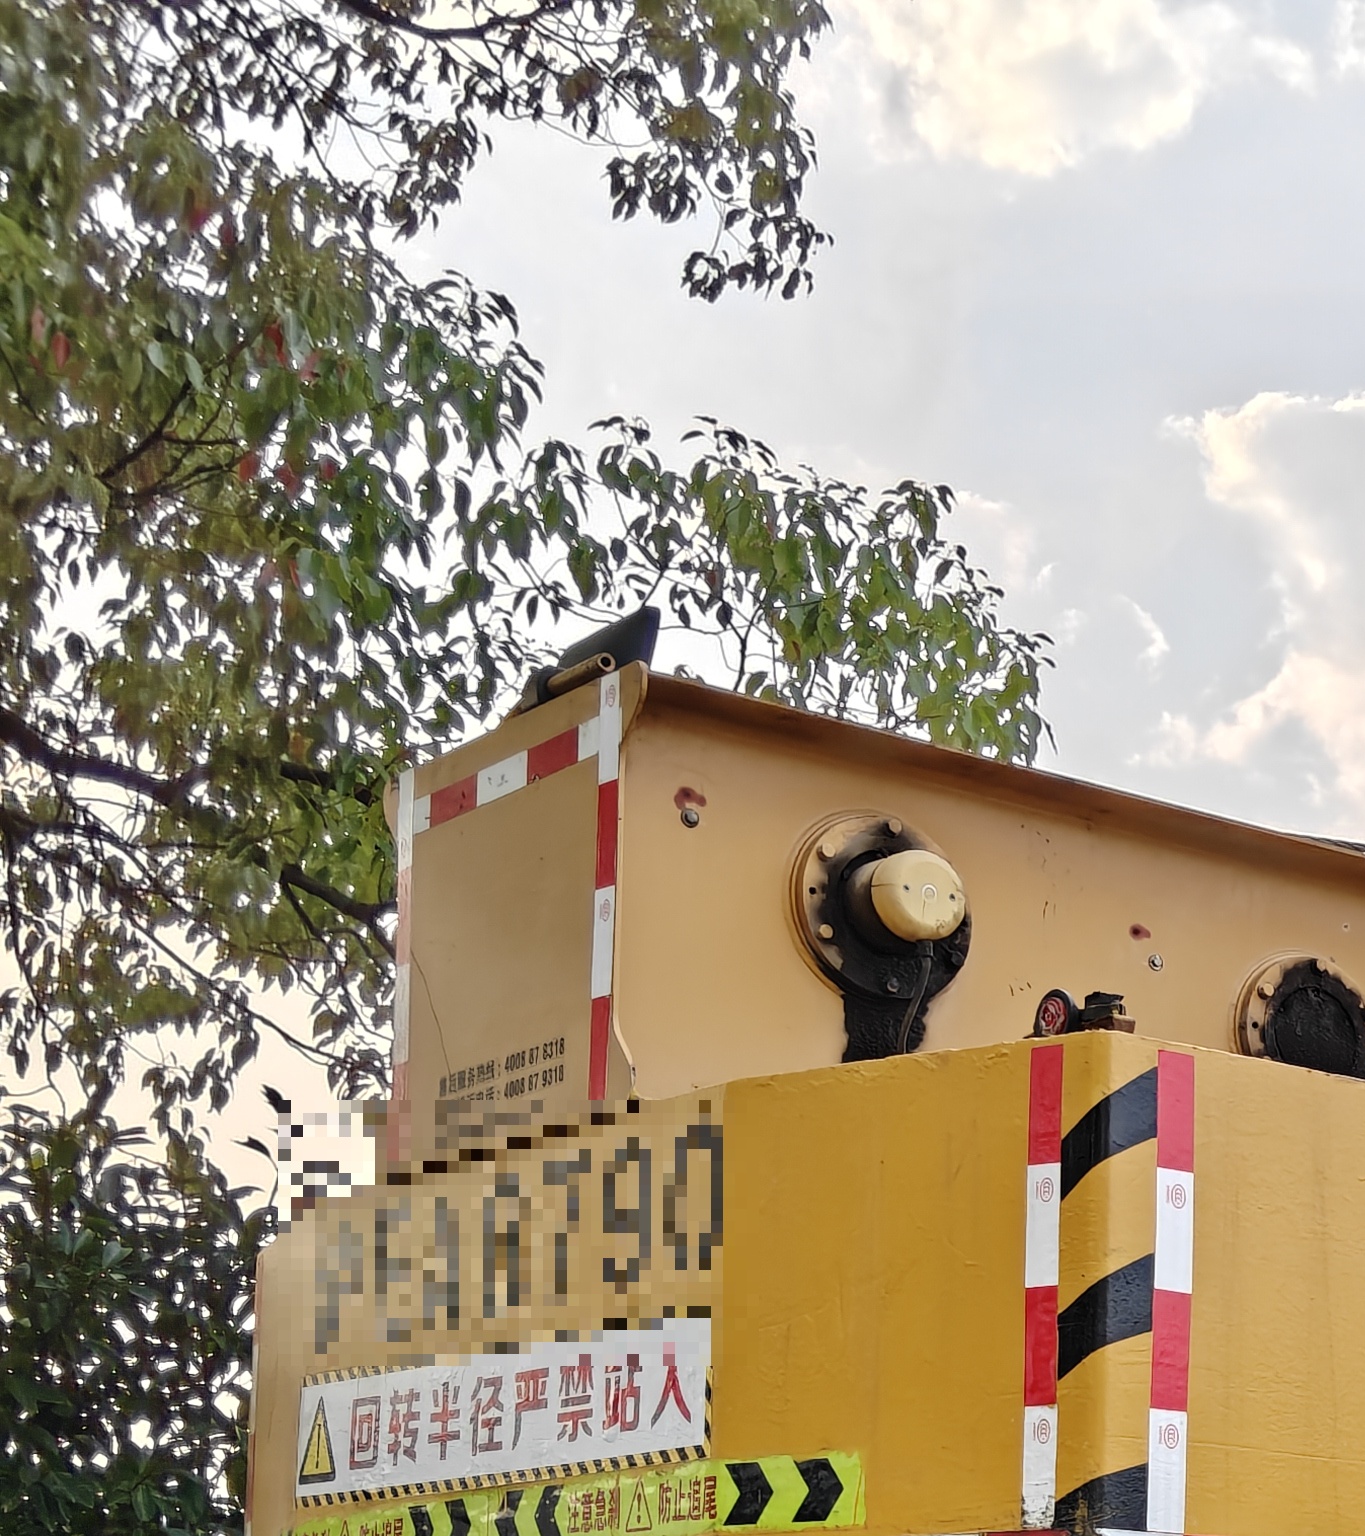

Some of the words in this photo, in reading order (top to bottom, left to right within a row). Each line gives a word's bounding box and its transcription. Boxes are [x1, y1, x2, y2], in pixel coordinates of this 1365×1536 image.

[504, 1050, 526, 1073] 4008
[528, 1046, 540, 1066] 87
[542, 1037, 565, 1060] 8318
[503, 1077, 525, 1100] 4008
[527, 1072, 539, 1091] 87
[541, 1064, 564, 1087] 9318
[348, 1343, 692, 1471] 回转半径严禁站人
[567, 1487, 621, 1534] 注意急刹
[658, 1475, 718, 1525] 防止追尾
